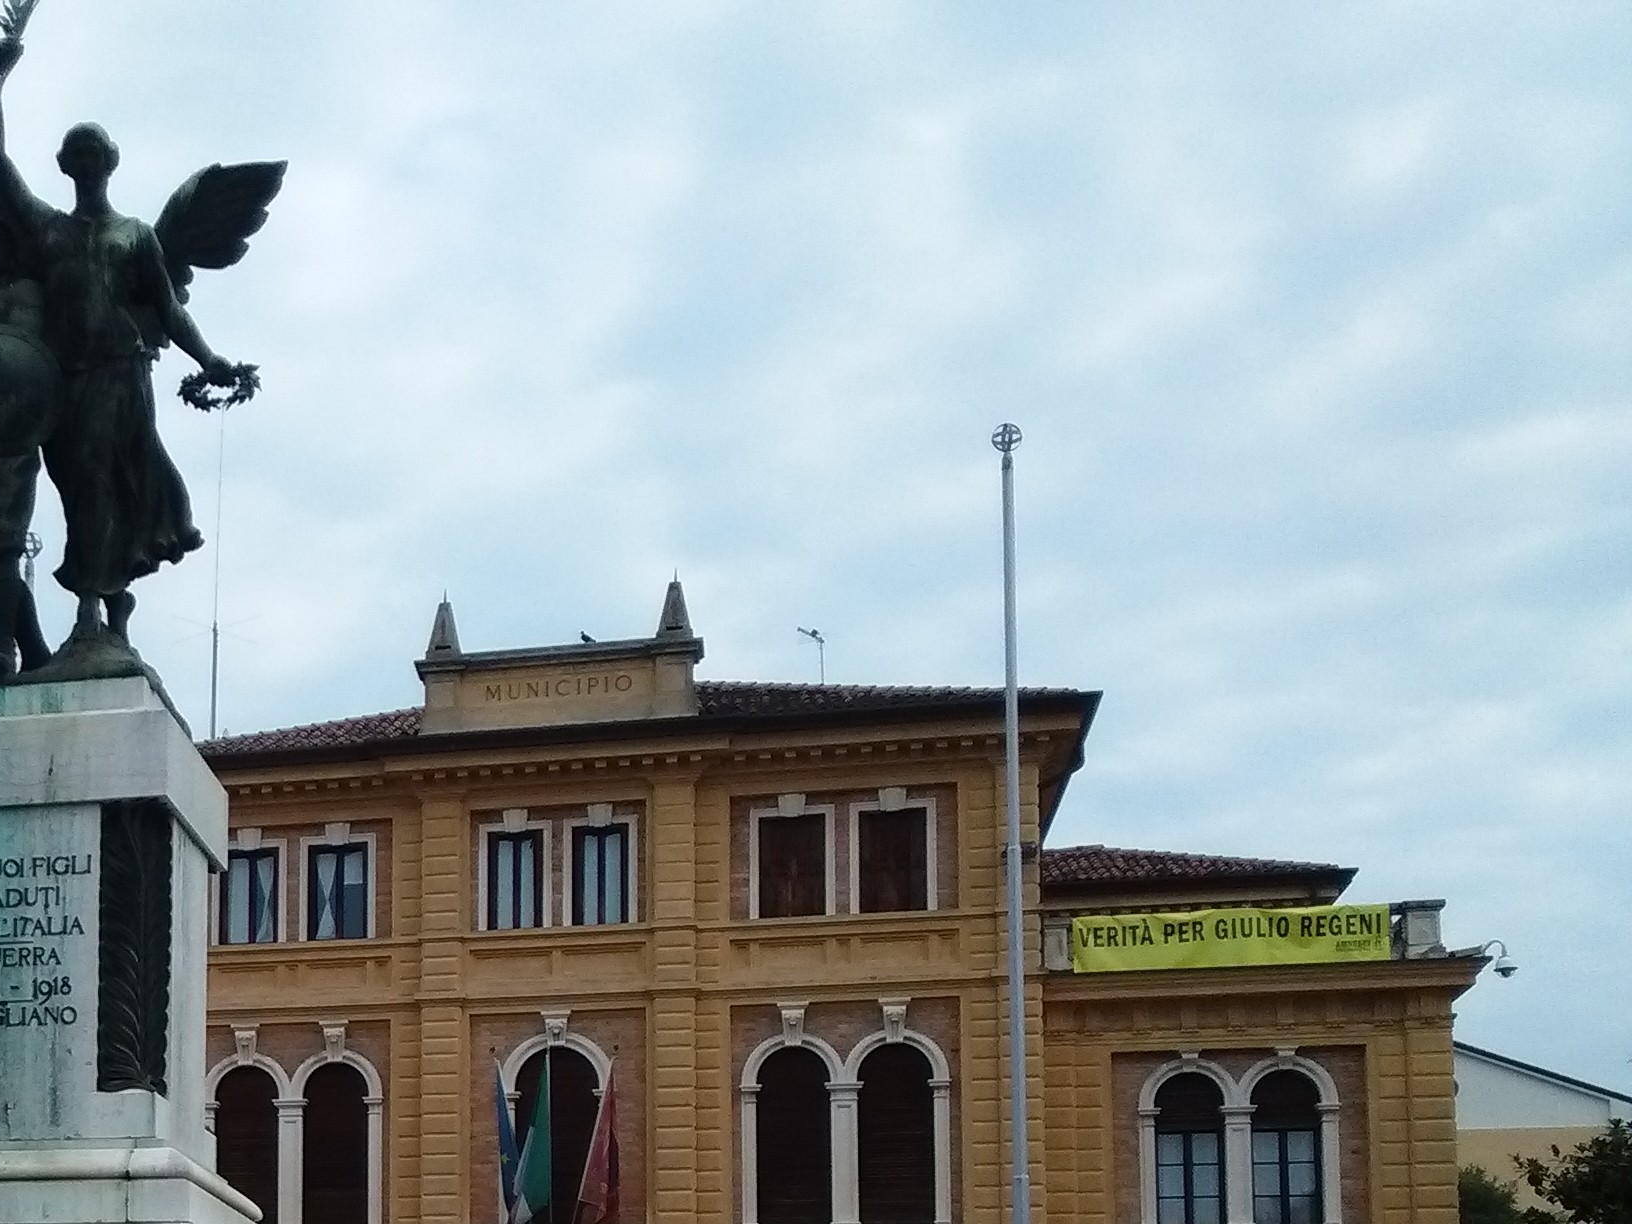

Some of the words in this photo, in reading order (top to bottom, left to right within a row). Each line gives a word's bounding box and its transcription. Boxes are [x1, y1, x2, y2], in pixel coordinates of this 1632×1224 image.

[484, 674, 633, 702] MUNICIPIO
[31, 854, 92, 877] FIGLI
[1078, 918, 1155, 948] VERITÀ
[1163, 920, 1205, 945] PER
[1214, 916, 1290, 940] GIULIO
[1300, 912, 1382, 938] REGENI
[32, 977, 72, 1005] 1918
